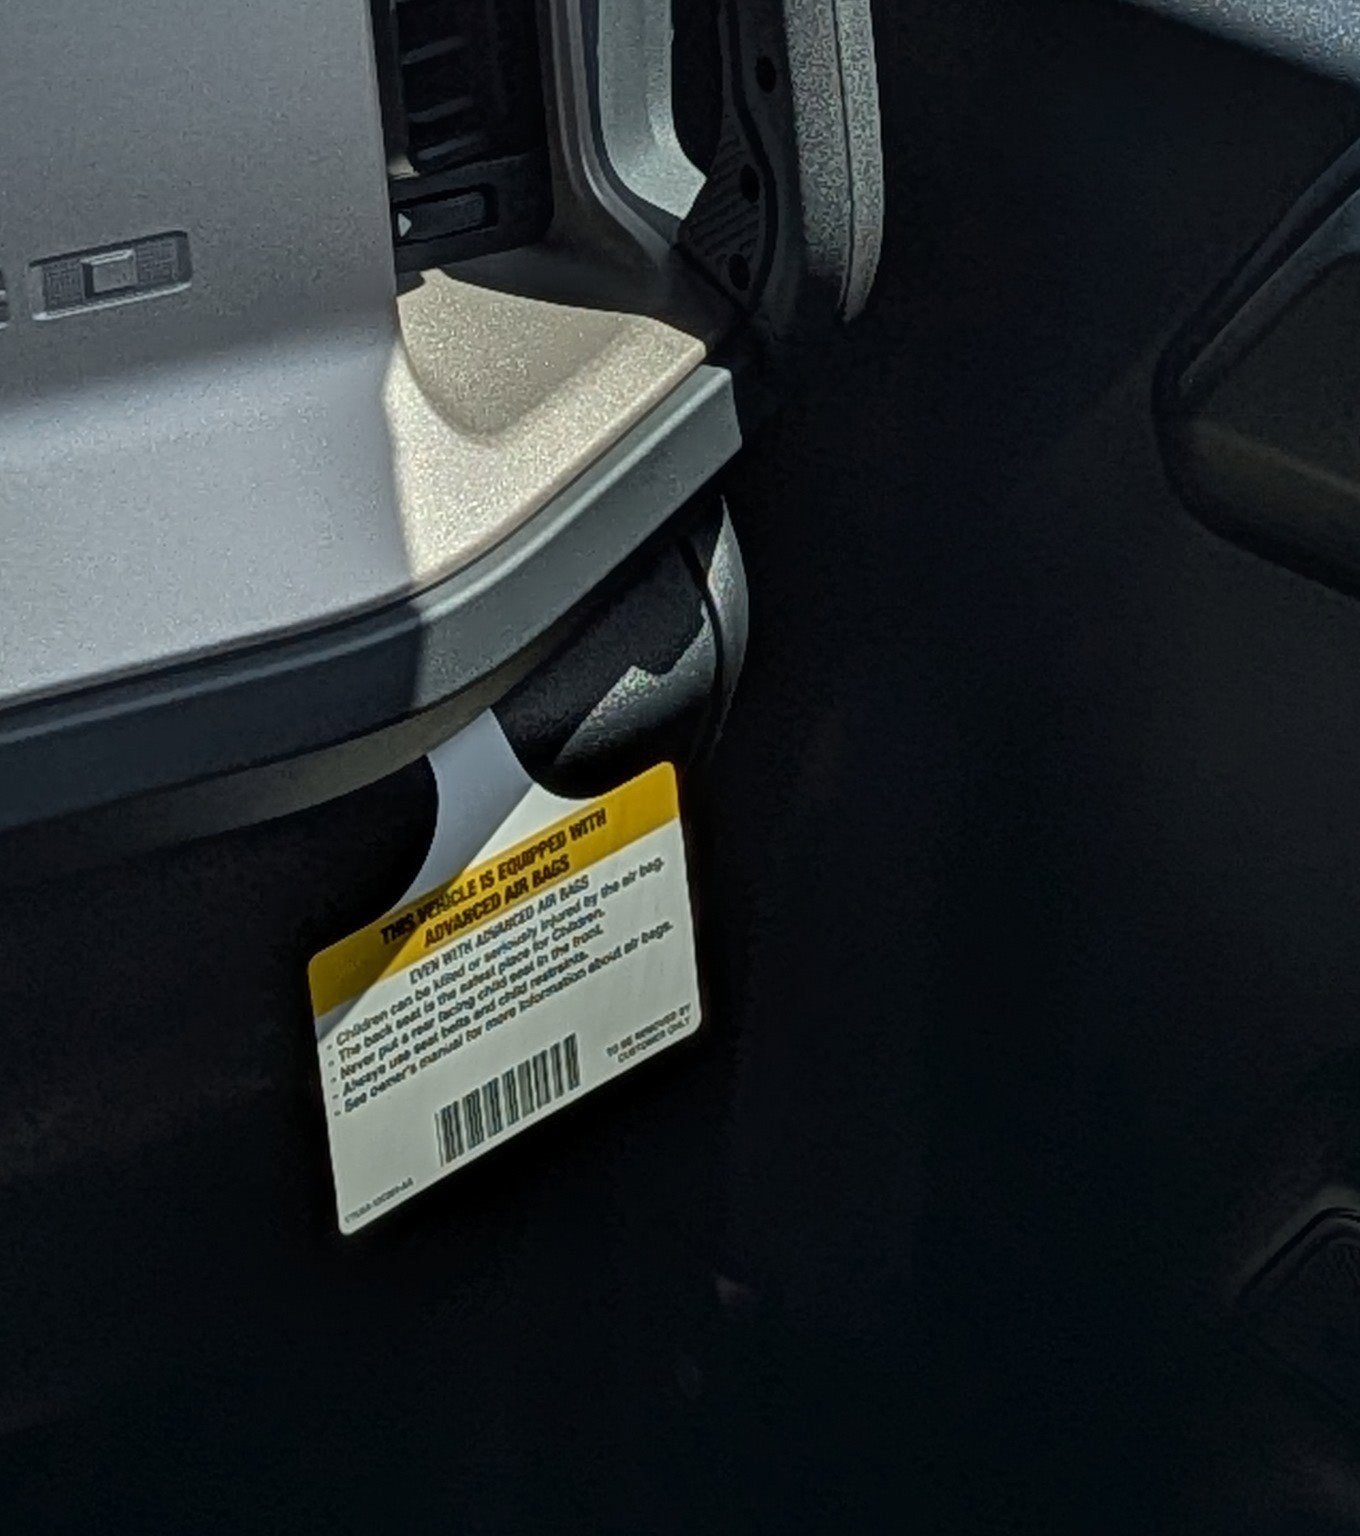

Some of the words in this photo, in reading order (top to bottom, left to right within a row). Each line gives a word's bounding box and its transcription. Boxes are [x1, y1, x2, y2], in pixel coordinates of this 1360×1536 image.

[380, 913, 414, 944] THIS
[416, 879, 476, 924] VEHICLE
[479, 870, 494, 891] IS
[497, 830, 567, 881] EQUIPPED
[569, 809, 606, 840] WITH
[409, 958, 439, 983] EVEN
[442, 940, 472, 965] WITH
[475, 905, 534, 947] ADVANCED
[536, 893, 556, 914] AIR
[559, 875, 589, 901] BAGS
[423, 892, 501, 947] ADVANCED
[503, 876, 528, 902] AIR
[531, 854, 569, 887] BAGS
[335, 1008, 388, 1045] Children
[390, 997, 412, 1015] can
[414, 984, 430, 1001] be
[600, 879, 620, 899] the
